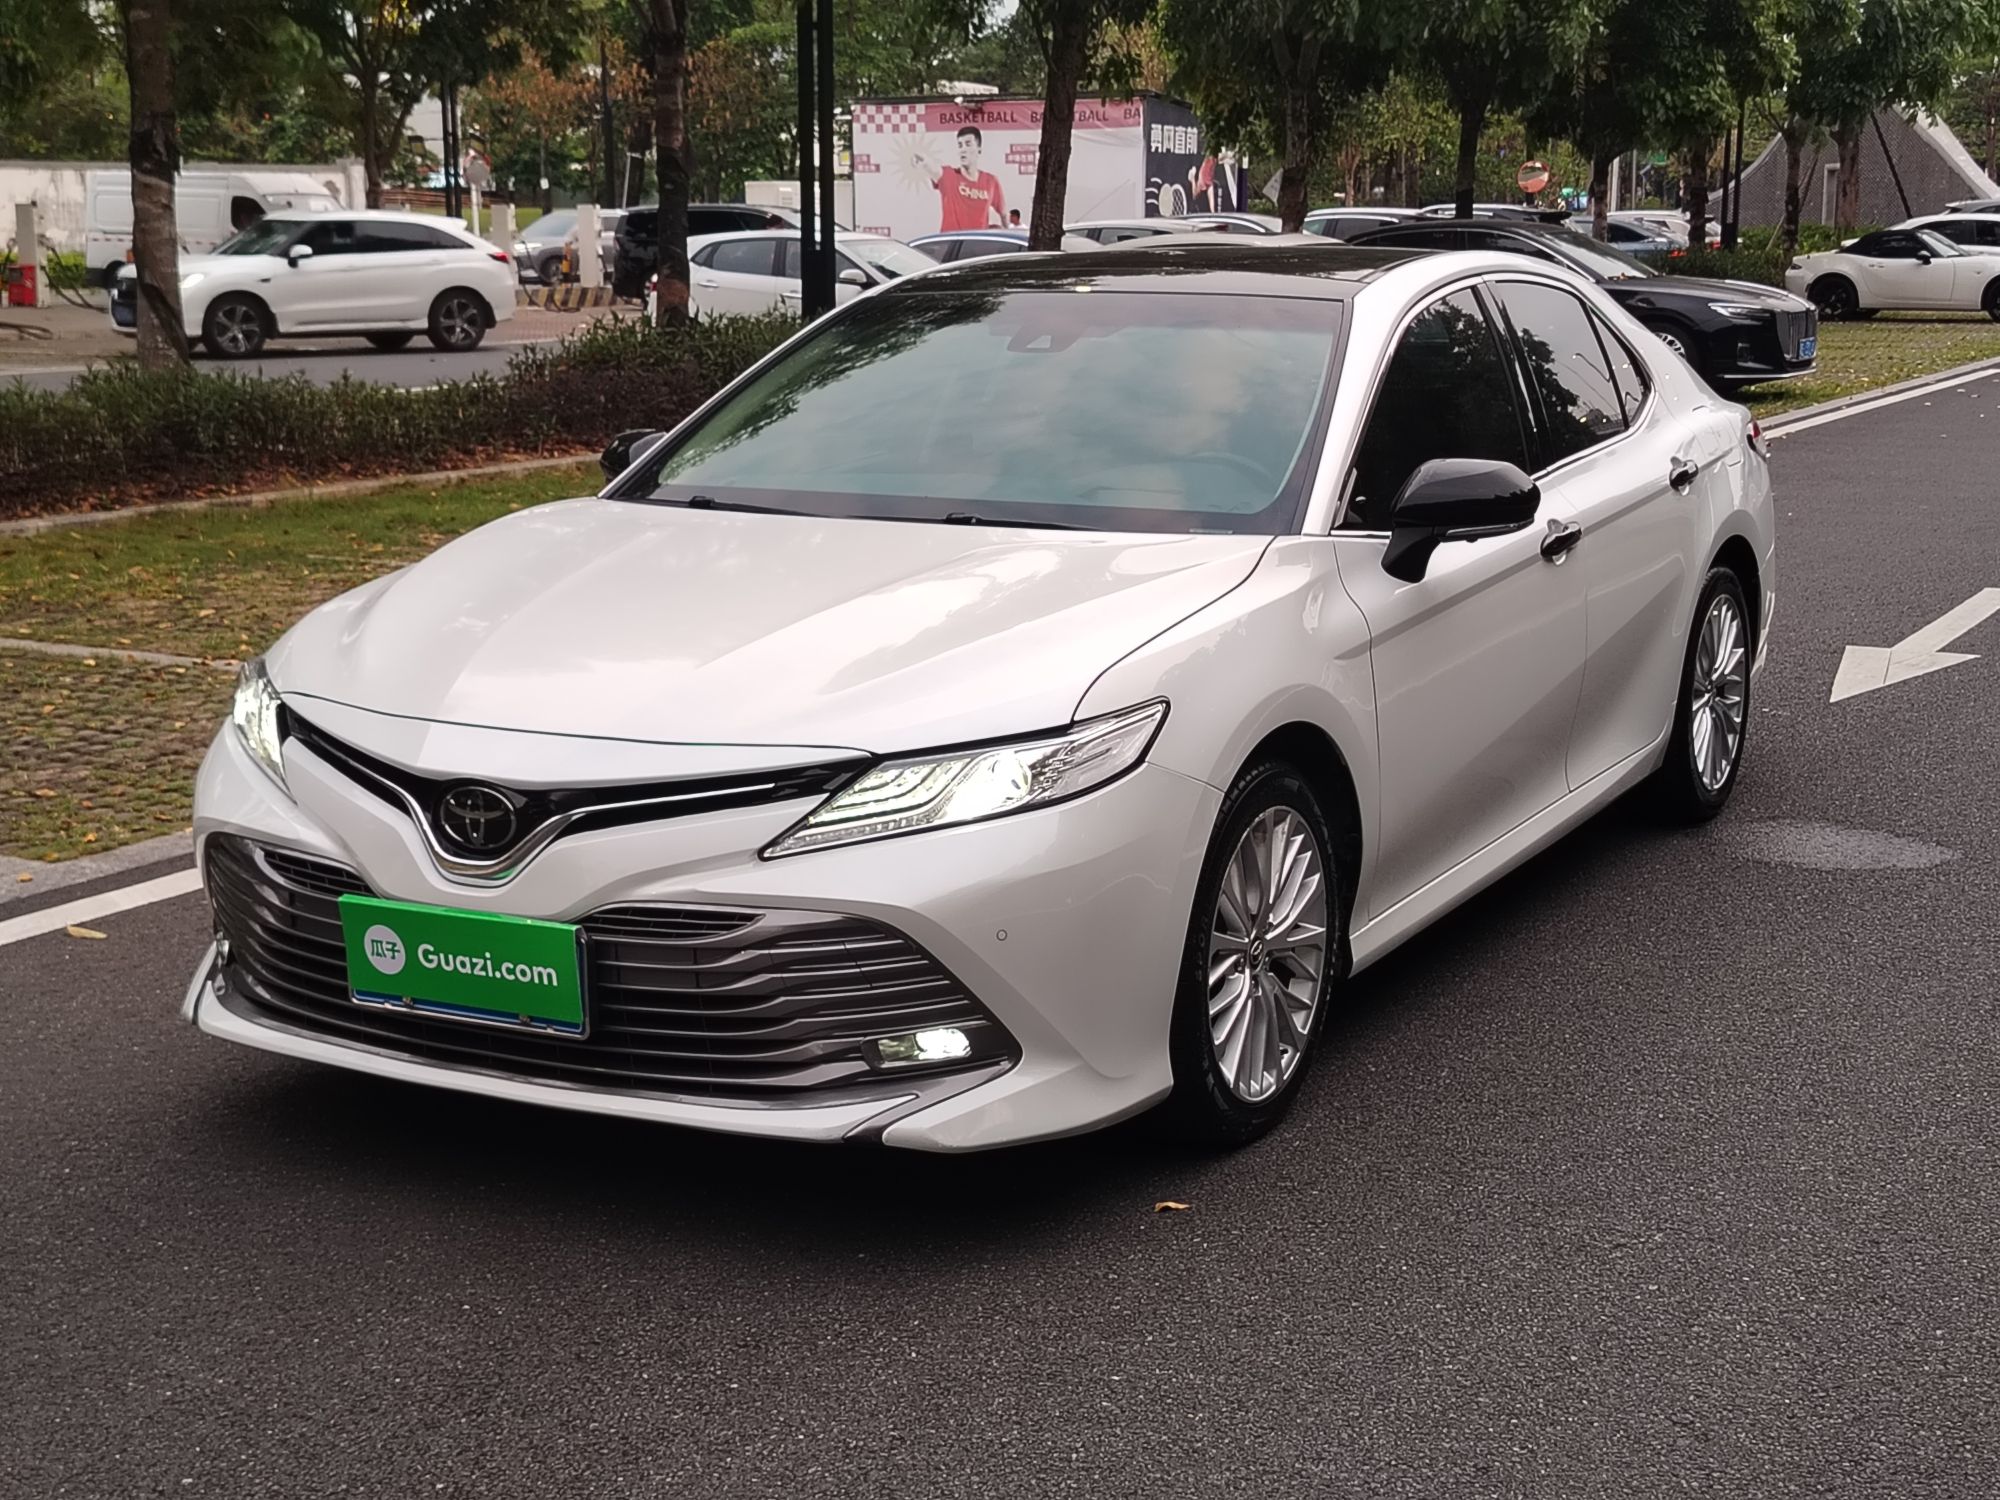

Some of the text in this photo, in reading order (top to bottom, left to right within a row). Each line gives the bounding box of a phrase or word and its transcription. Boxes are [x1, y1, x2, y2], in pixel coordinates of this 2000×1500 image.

[939, 111, 1017, 124] BASKETBALL
[958, 185, 989, 200] CHINA
[370, 938, 401, 960] 瓜子
[417, 943, 559, 987] Guazi.com
